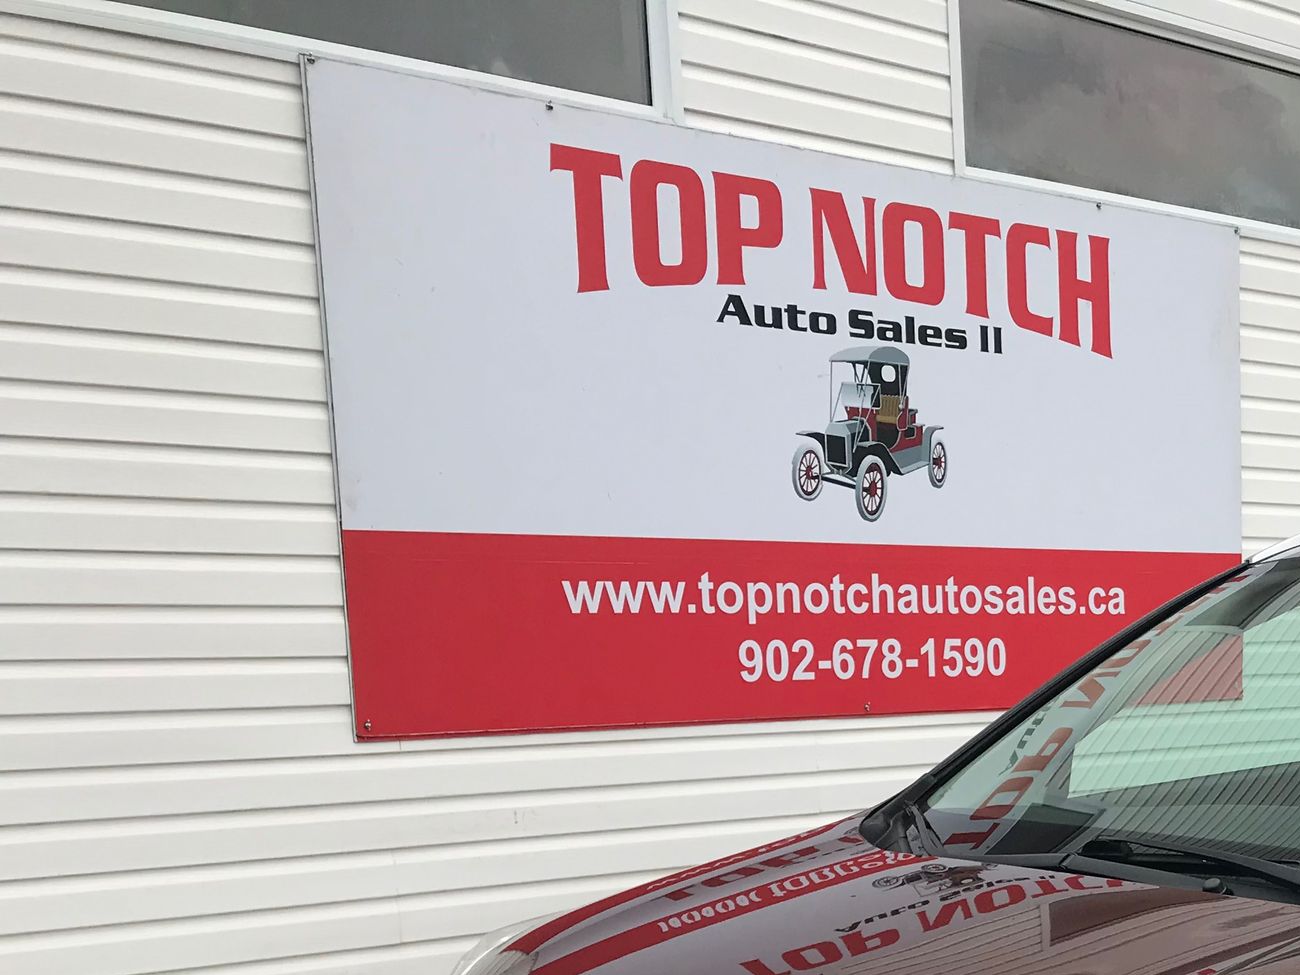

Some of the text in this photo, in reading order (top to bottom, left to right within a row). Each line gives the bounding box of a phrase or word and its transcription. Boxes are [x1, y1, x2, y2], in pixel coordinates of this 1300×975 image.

[549, 143, 1112, 359] TOP NOTCH
[716, 293, 837, 335] Auto
[848, 309, 968, 350] Sales
[561, 571, 1127, 624] www.topnotchautosales.ca
[738, 637, 1007, 683] 902-678-1590
